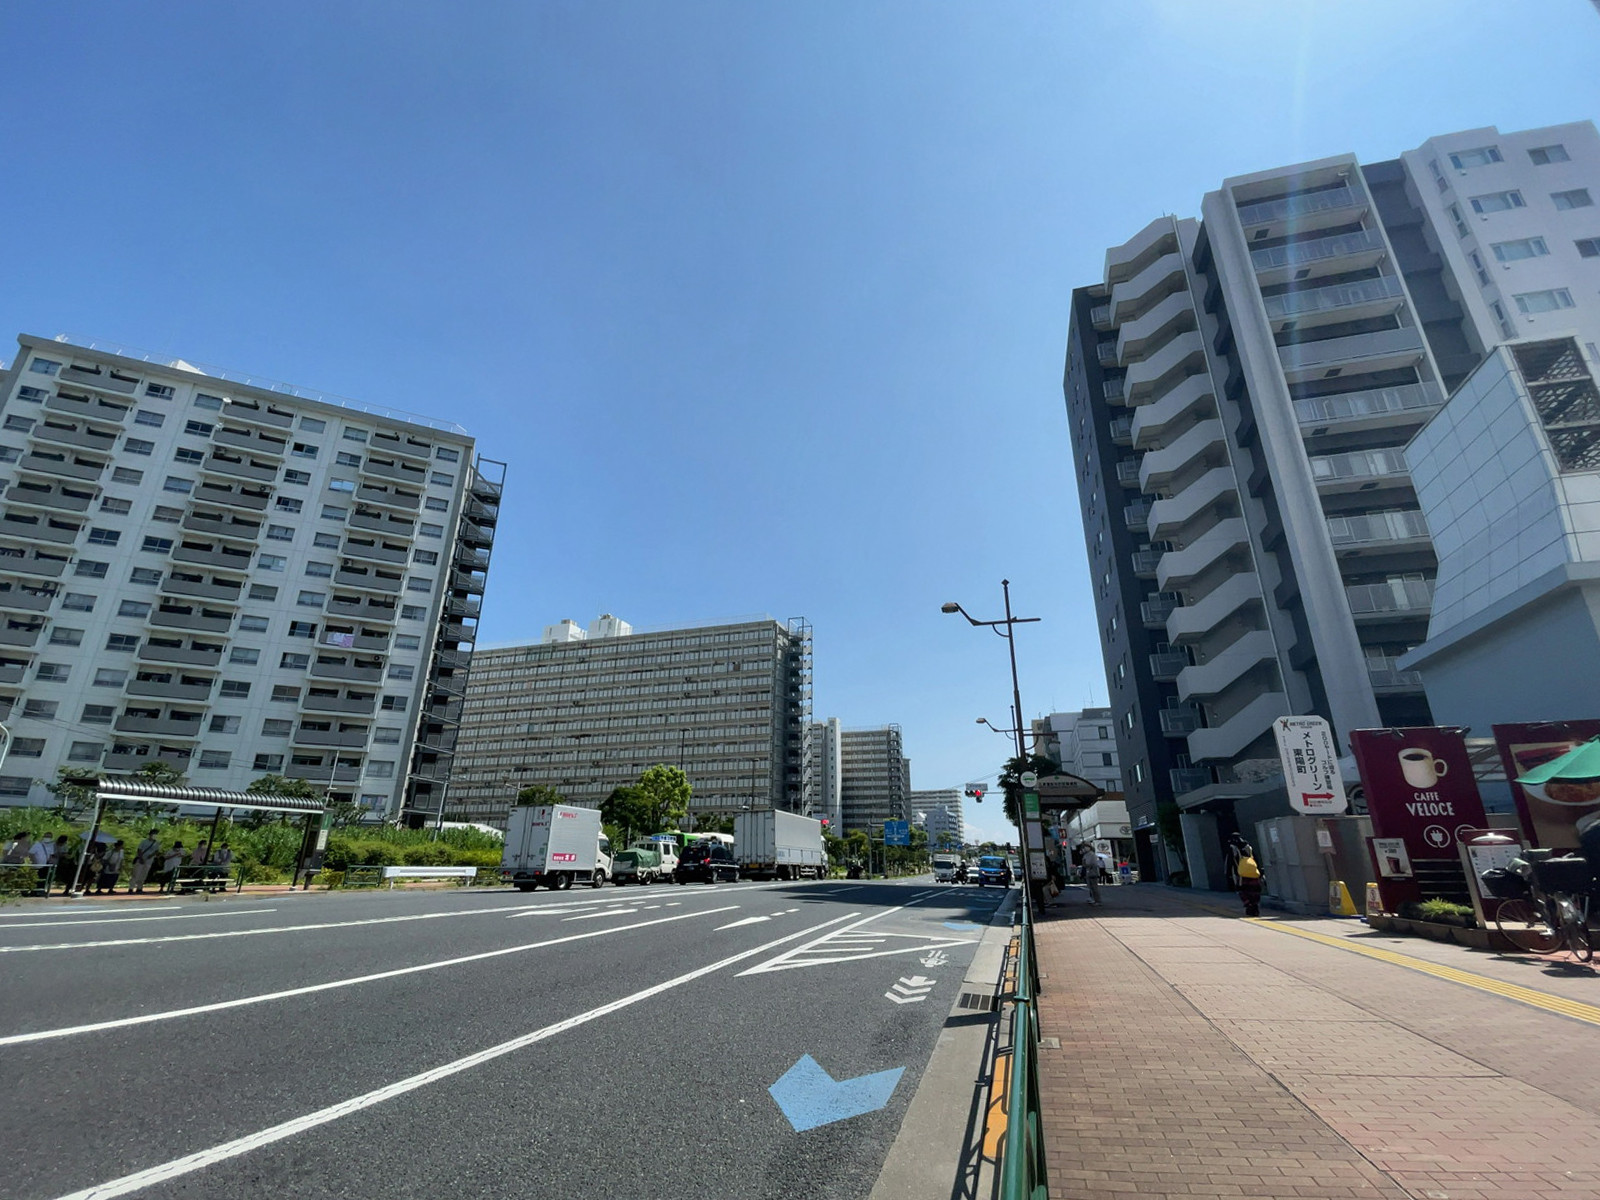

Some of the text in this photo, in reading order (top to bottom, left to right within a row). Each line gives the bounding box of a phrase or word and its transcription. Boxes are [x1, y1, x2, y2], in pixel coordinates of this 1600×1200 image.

[1303, 731, 1322, 791] メトログリーン
[1413, 791, 1440, 801] CAFFE
[1405, 802, 1455, 816] VELOCE
